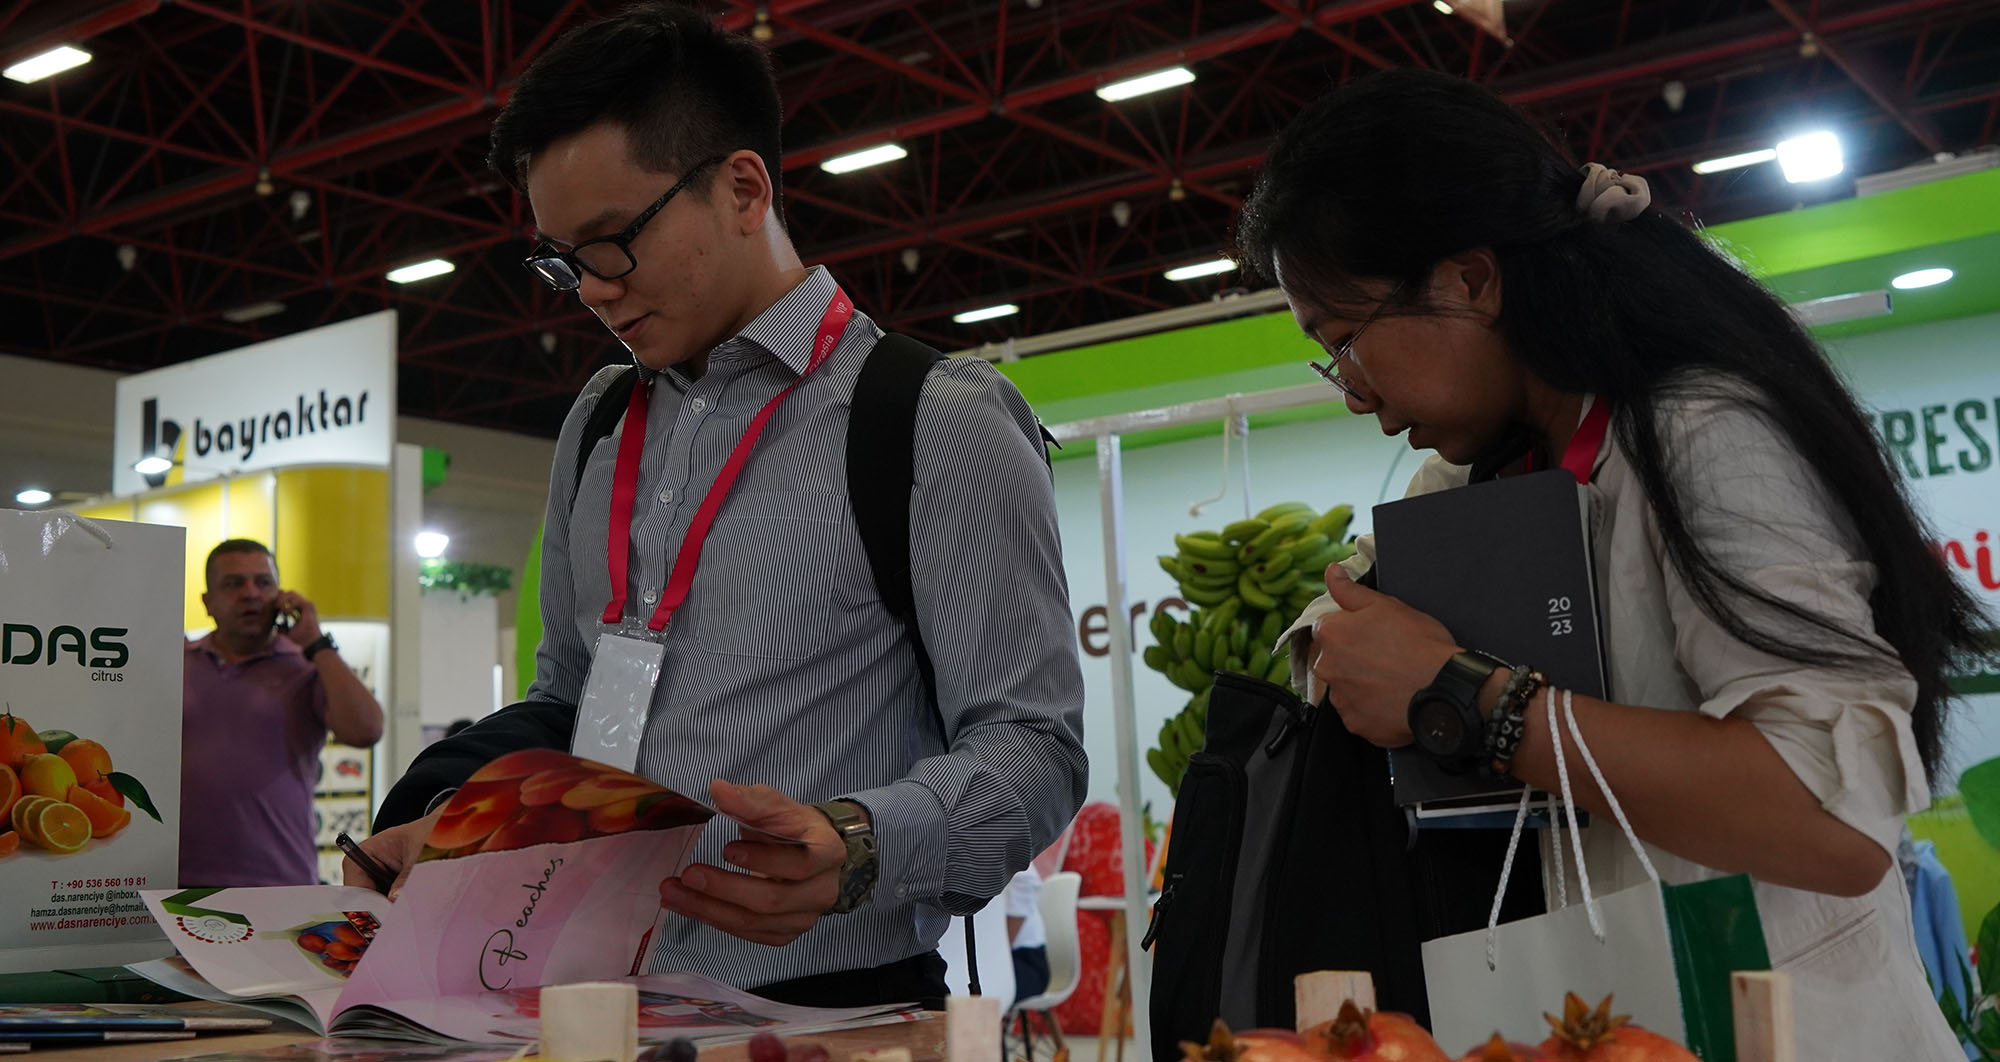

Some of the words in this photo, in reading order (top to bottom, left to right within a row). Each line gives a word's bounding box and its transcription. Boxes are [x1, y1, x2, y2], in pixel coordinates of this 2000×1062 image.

[835, 302, 848, 314] VIP
[195, 390, 369, 462] bayraktar
[1872, 396, 2000, 481] RES
[1548, 597, 1571, 613] 20
[1551, 619, 1573, 636] 23
[91, 670, 124, 682] citrus
[51, 881, 58, 890] T
[66, 880, 83, 889] +90
[86, 879, 102, 888] 536
[105, 878, 121, 888] 560
[124, 877, 134, 886] 19
[136, 876, 146, 886] 81
[51, 890, 104, 903] das.narenciye
[479, 857, 565, 991] Peaches
